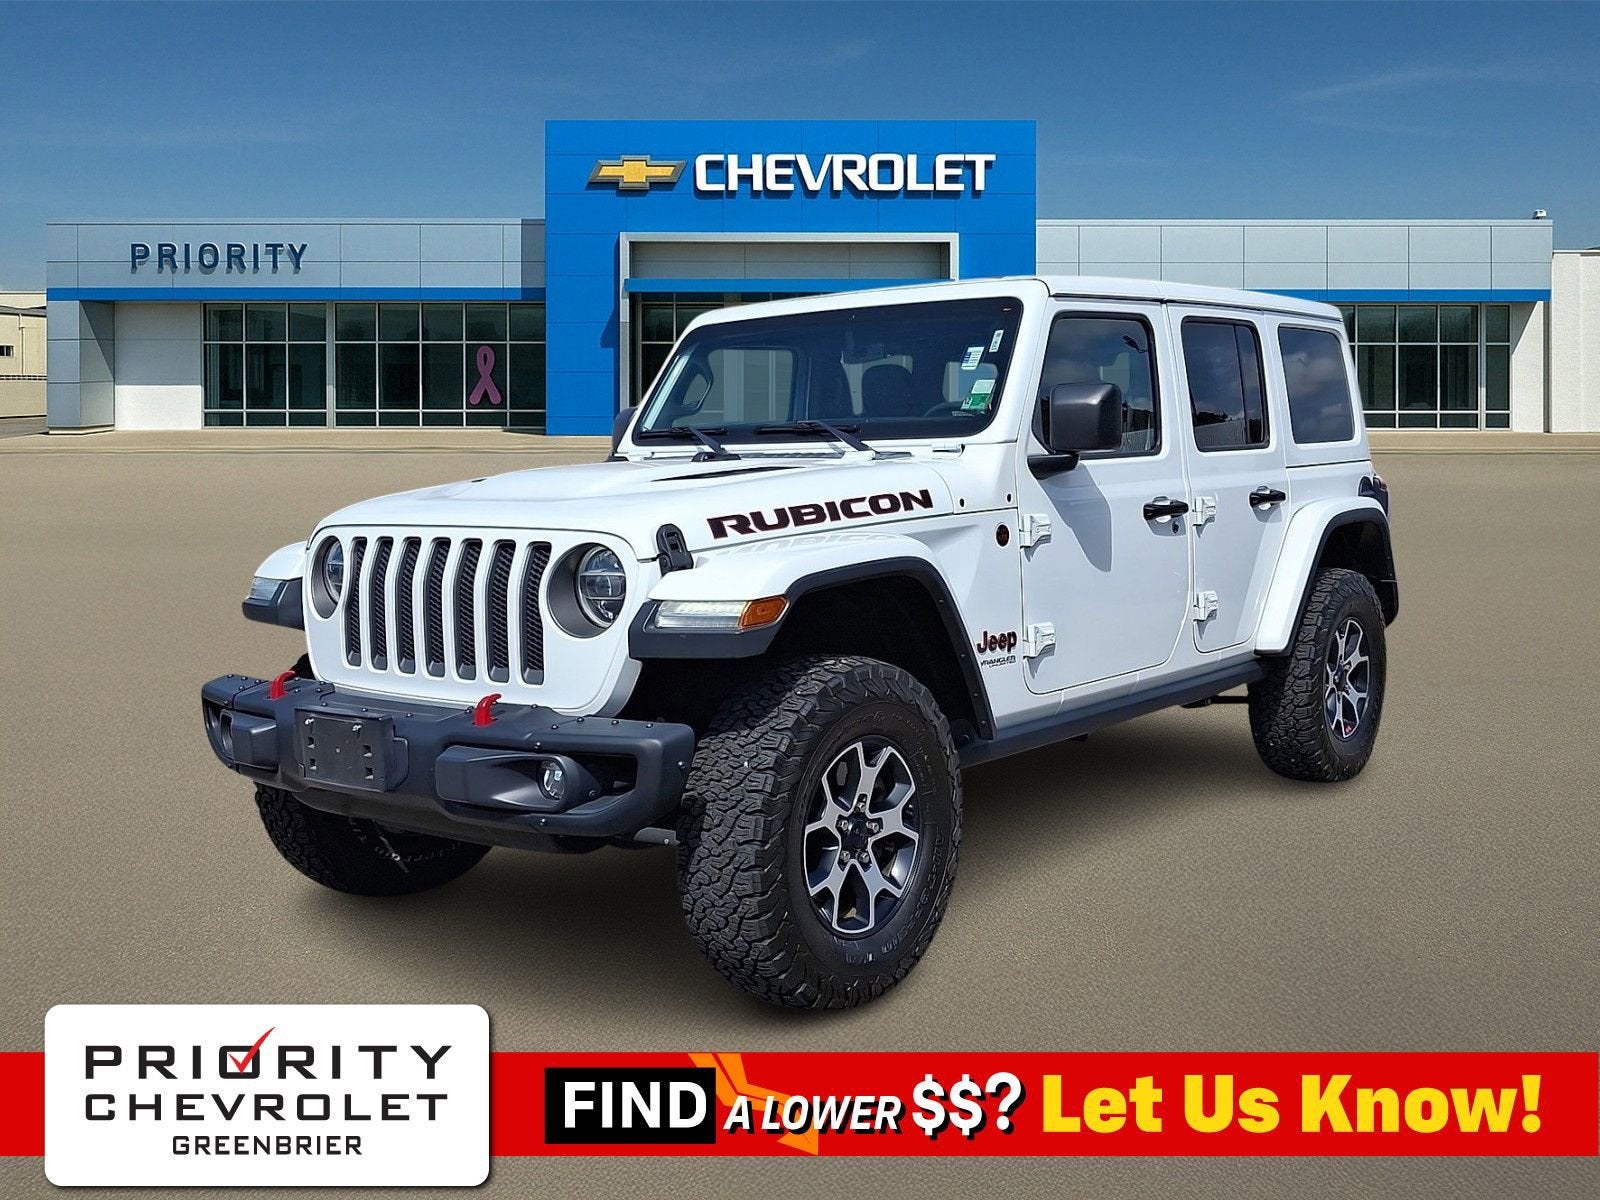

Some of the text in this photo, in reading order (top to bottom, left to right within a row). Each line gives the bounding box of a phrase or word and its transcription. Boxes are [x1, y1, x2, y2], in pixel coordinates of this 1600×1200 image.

[694, 153, 996, 192] CHEVROLET
[130, 243, 308, 271] PRIORITY
[706, 489, 933, 539] RUBICON
[977, 630, 1017, 653] Jeep
